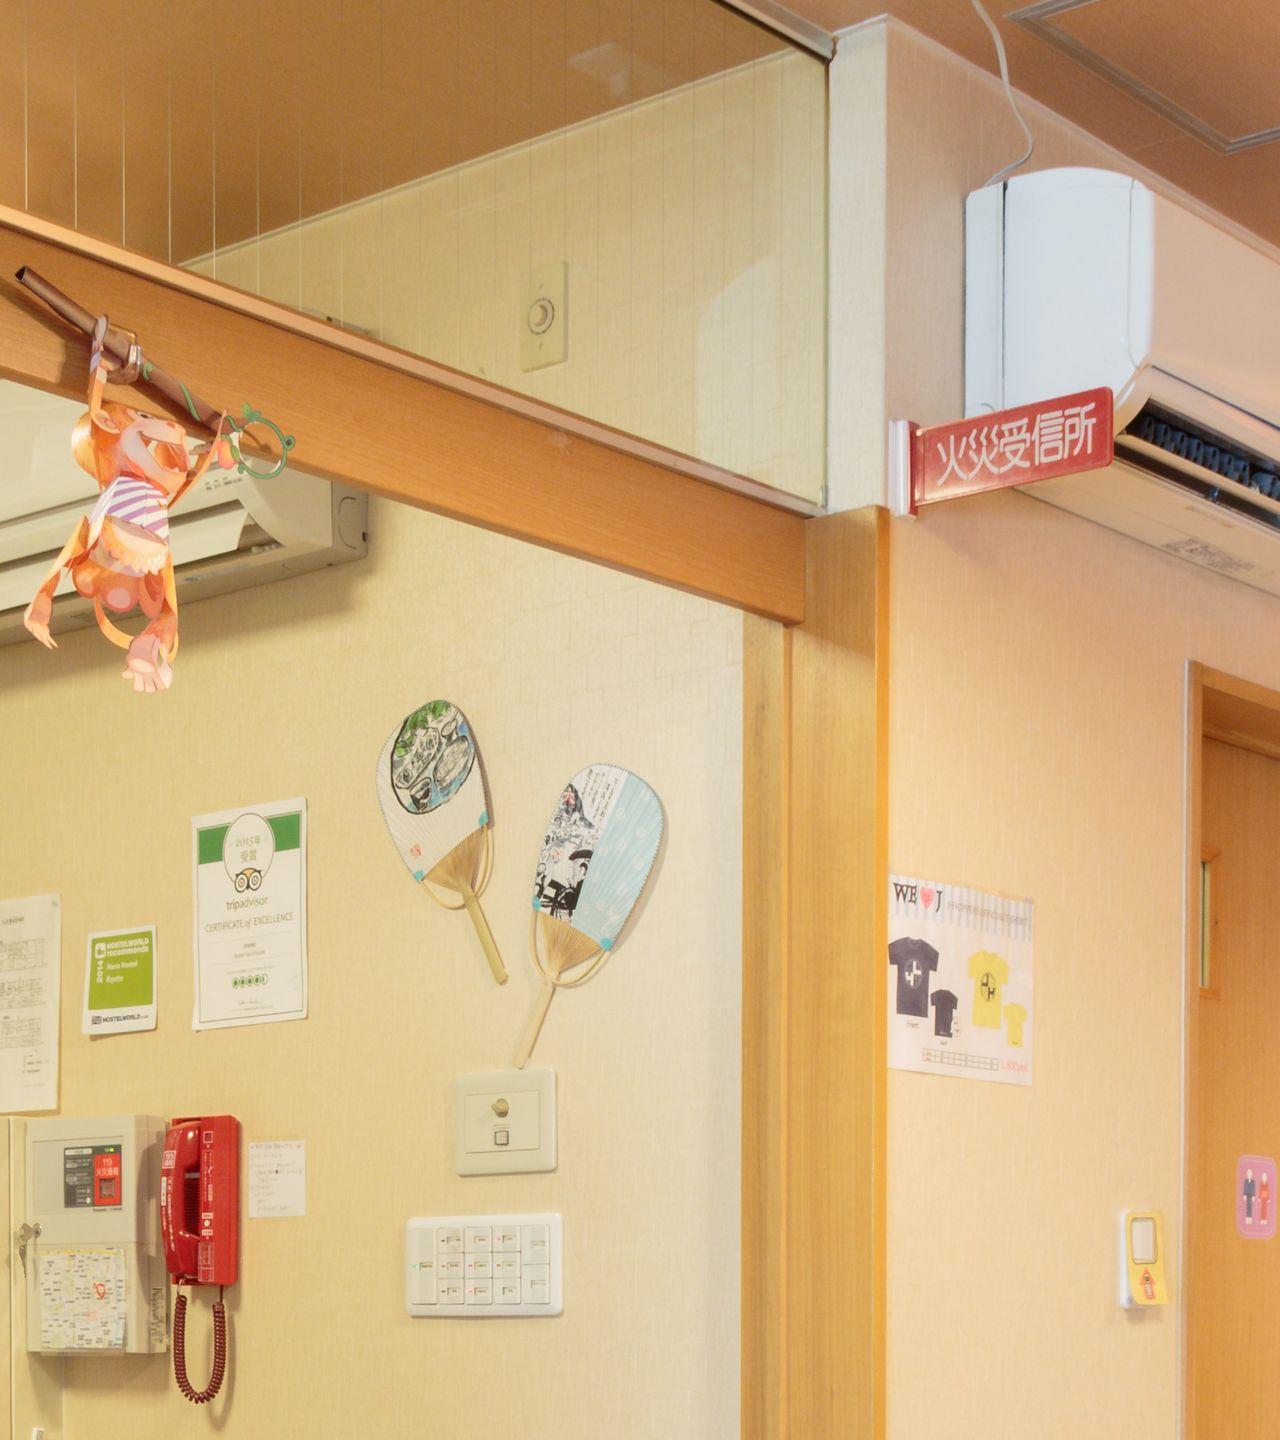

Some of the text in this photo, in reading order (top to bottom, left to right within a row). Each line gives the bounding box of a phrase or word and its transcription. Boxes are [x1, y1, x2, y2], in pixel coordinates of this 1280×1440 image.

[936, 402, 1097, 486] 火災受信所
[226, 896, 269, 912] tripadvisor
[892, 882, 918, 904] WE
